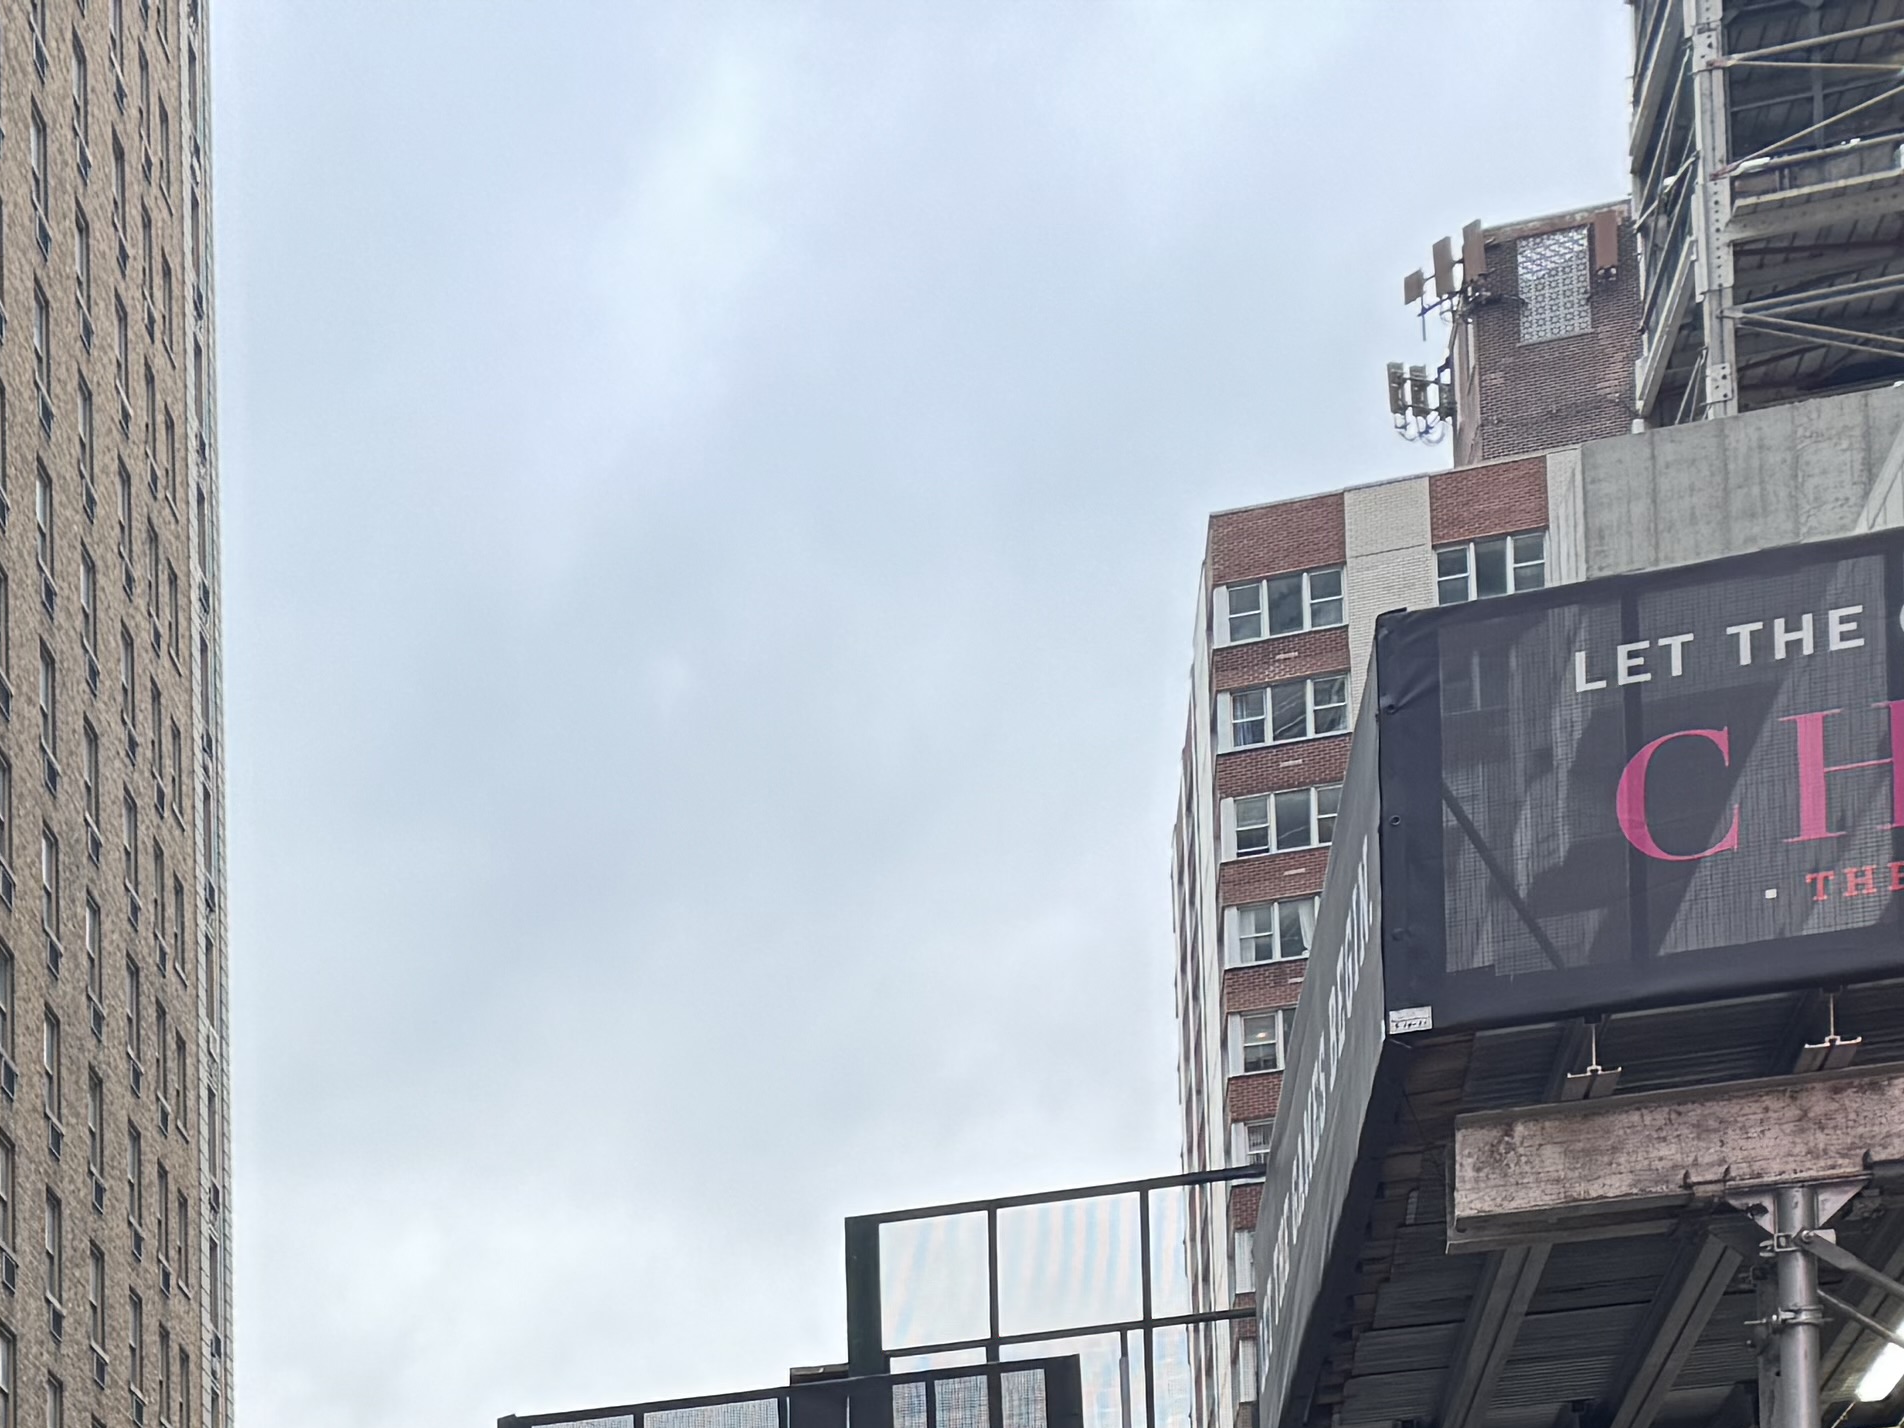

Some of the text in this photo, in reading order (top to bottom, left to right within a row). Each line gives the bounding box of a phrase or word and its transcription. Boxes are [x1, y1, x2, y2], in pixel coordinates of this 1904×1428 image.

[1575, 605, 1865, 694] LET THE
[1292, 1030, 1328, 1247] GAMES
